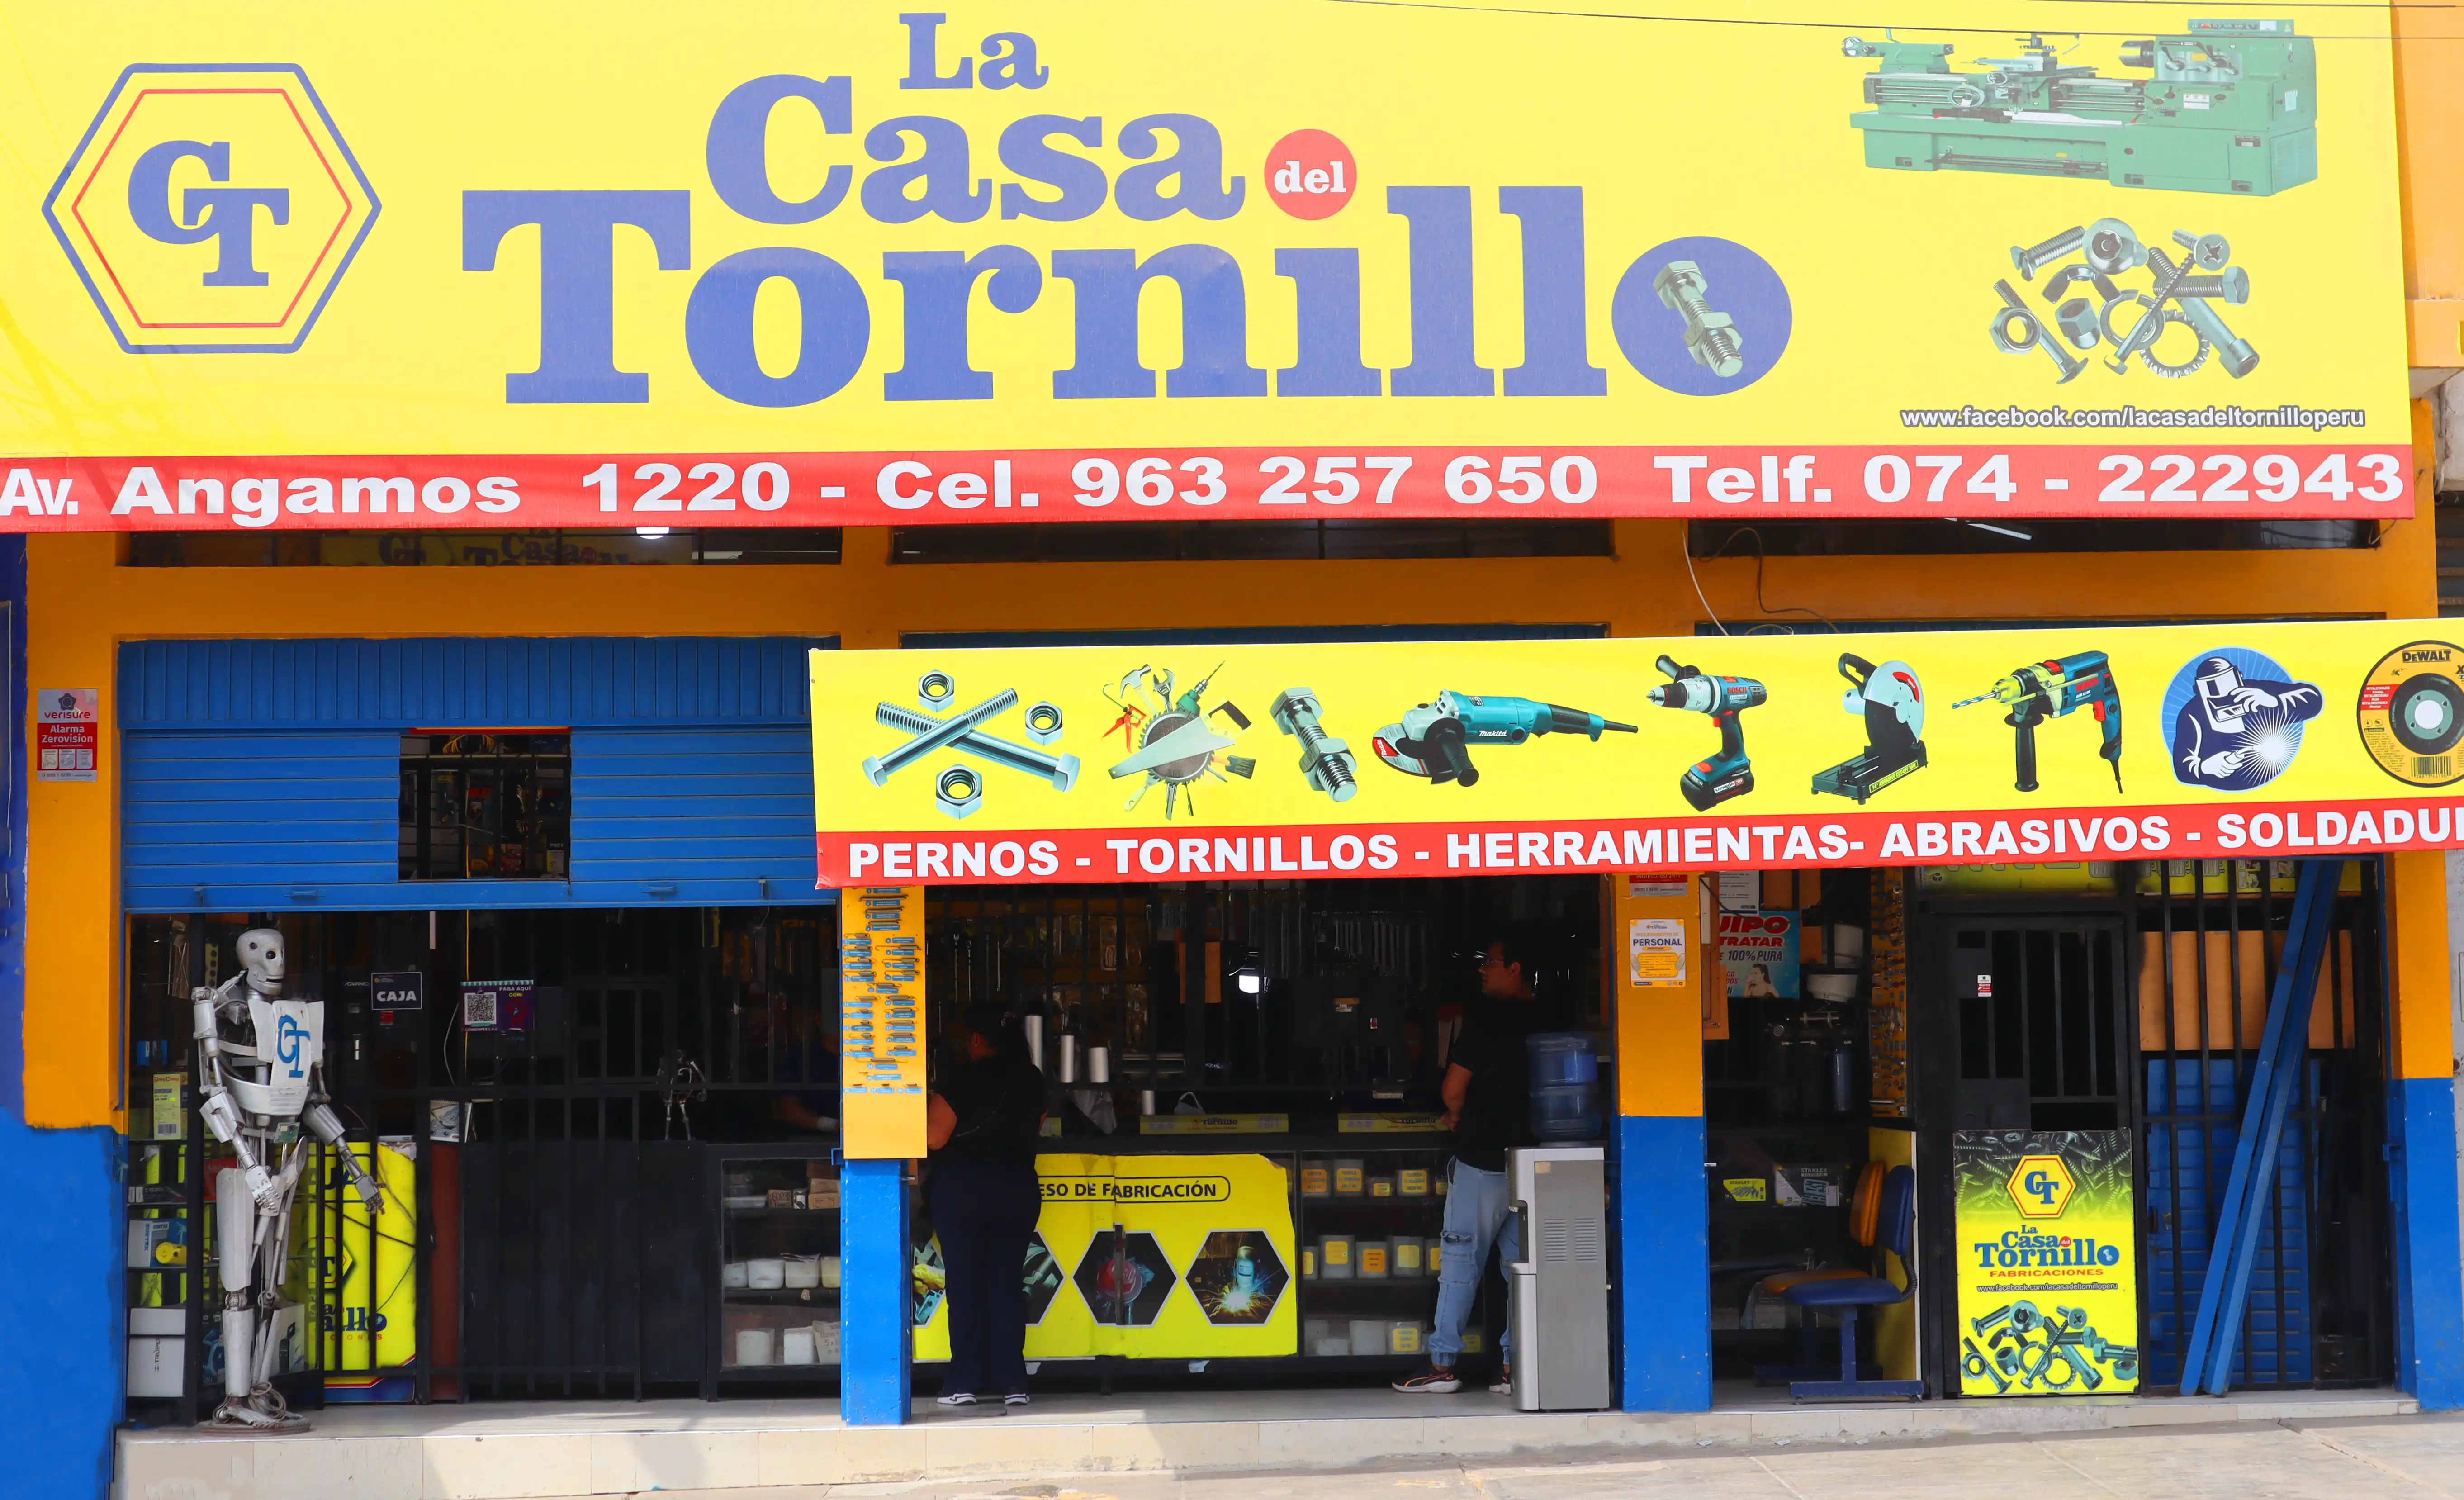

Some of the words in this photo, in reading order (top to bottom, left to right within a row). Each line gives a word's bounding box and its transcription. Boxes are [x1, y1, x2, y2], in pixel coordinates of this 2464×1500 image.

[900, 13, 1048, 89] La
[707, 75, 1244, 224] Casa
[1274, 161, 1346, 194] del
[464, 187, 1791, 407] Tornillo
[1900, 405, 2365, 432] www.facebook.com/lacasadeltornilloperu
[0, 469, 78, 516] Av.
[110, 467, 520, 526] Angamos
[583, 462, 789, 511] 1220
[877, 460, 1038, 509] Cel.
[1072, 457, 1226, 506] 963
[1258, 456, 1412, 504] 257
[1445, 456, 1597, 504] 650
[1654, 455, 1831, 503] Telf.
[1864, 454, 2017, 502] 074
[2098, 454, 2403, 502] 222943
[50, 724, 85, 733] Alarma
[42, 734, 93, 743] Zerovision
[850, 841, 1058, 877] PERNOS
[1107, 835, 1398, 873] TORNILLOS
[1880, 816, 2170, 857] ABRASIVOS
[1633, 938, 1682, 946] PERSONAL
[1728, 950, 1755, 961] 100%
[1756, 950, 1782, 962] PURA
[376, 990, 417, 1002] CAJA
[1075, 1183, 1096, 1196] DE
[1102, 1180, 1216, 1198] FABRICACIÓN
[2021, 1225, 2038, 1234] La
[2001, 1231, 2061, 1249] Casa
[1974, 1239, 2120, 1267] Tornillo
[1990, 1269, 2104, 1277] FABRICACIONES
[1977, 1282, 2118, 1292] www.facebook.com/lacasadeltornilloperu
